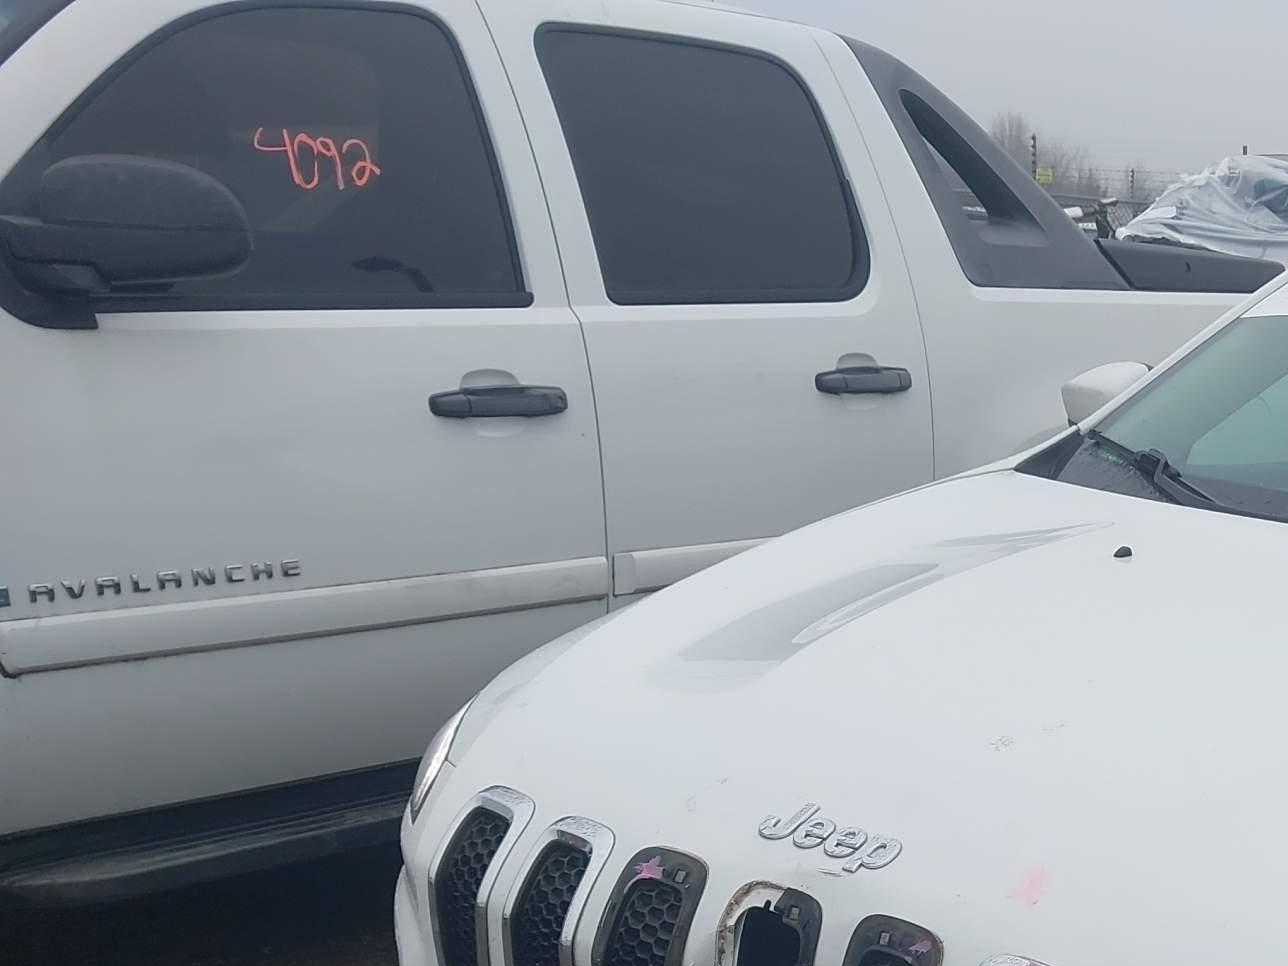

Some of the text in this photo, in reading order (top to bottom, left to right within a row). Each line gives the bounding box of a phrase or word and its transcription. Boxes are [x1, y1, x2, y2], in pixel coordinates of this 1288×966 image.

[253, 127, 381, 190] 4092
[28, 559, 301, 603] AVALANCHE
[758, 802, 903, 874] Jeep
